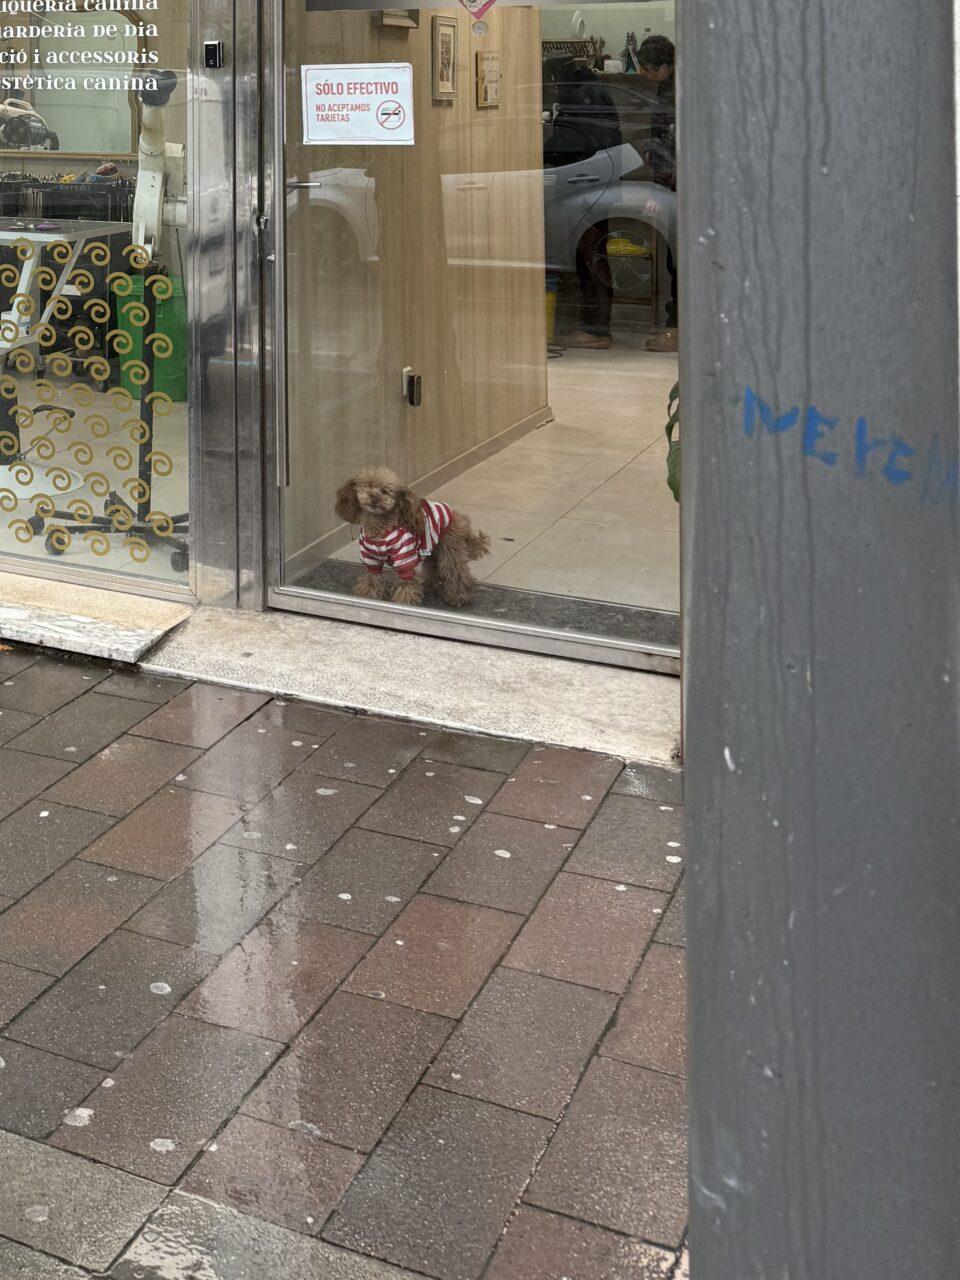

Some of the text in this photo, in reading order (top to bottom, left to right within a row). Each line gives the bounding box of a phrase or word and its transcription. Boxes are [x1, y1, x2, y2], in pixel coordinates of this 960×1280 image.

[33, 48, 41, 64] i
[83, 74, 158, 91] canina
[315, 79, 399, 96] SÓLO EFECTIVO
[315, 103, 371, 112] NO ACEPTAMOS
[316, 114, 350, 122] TARJETAS
